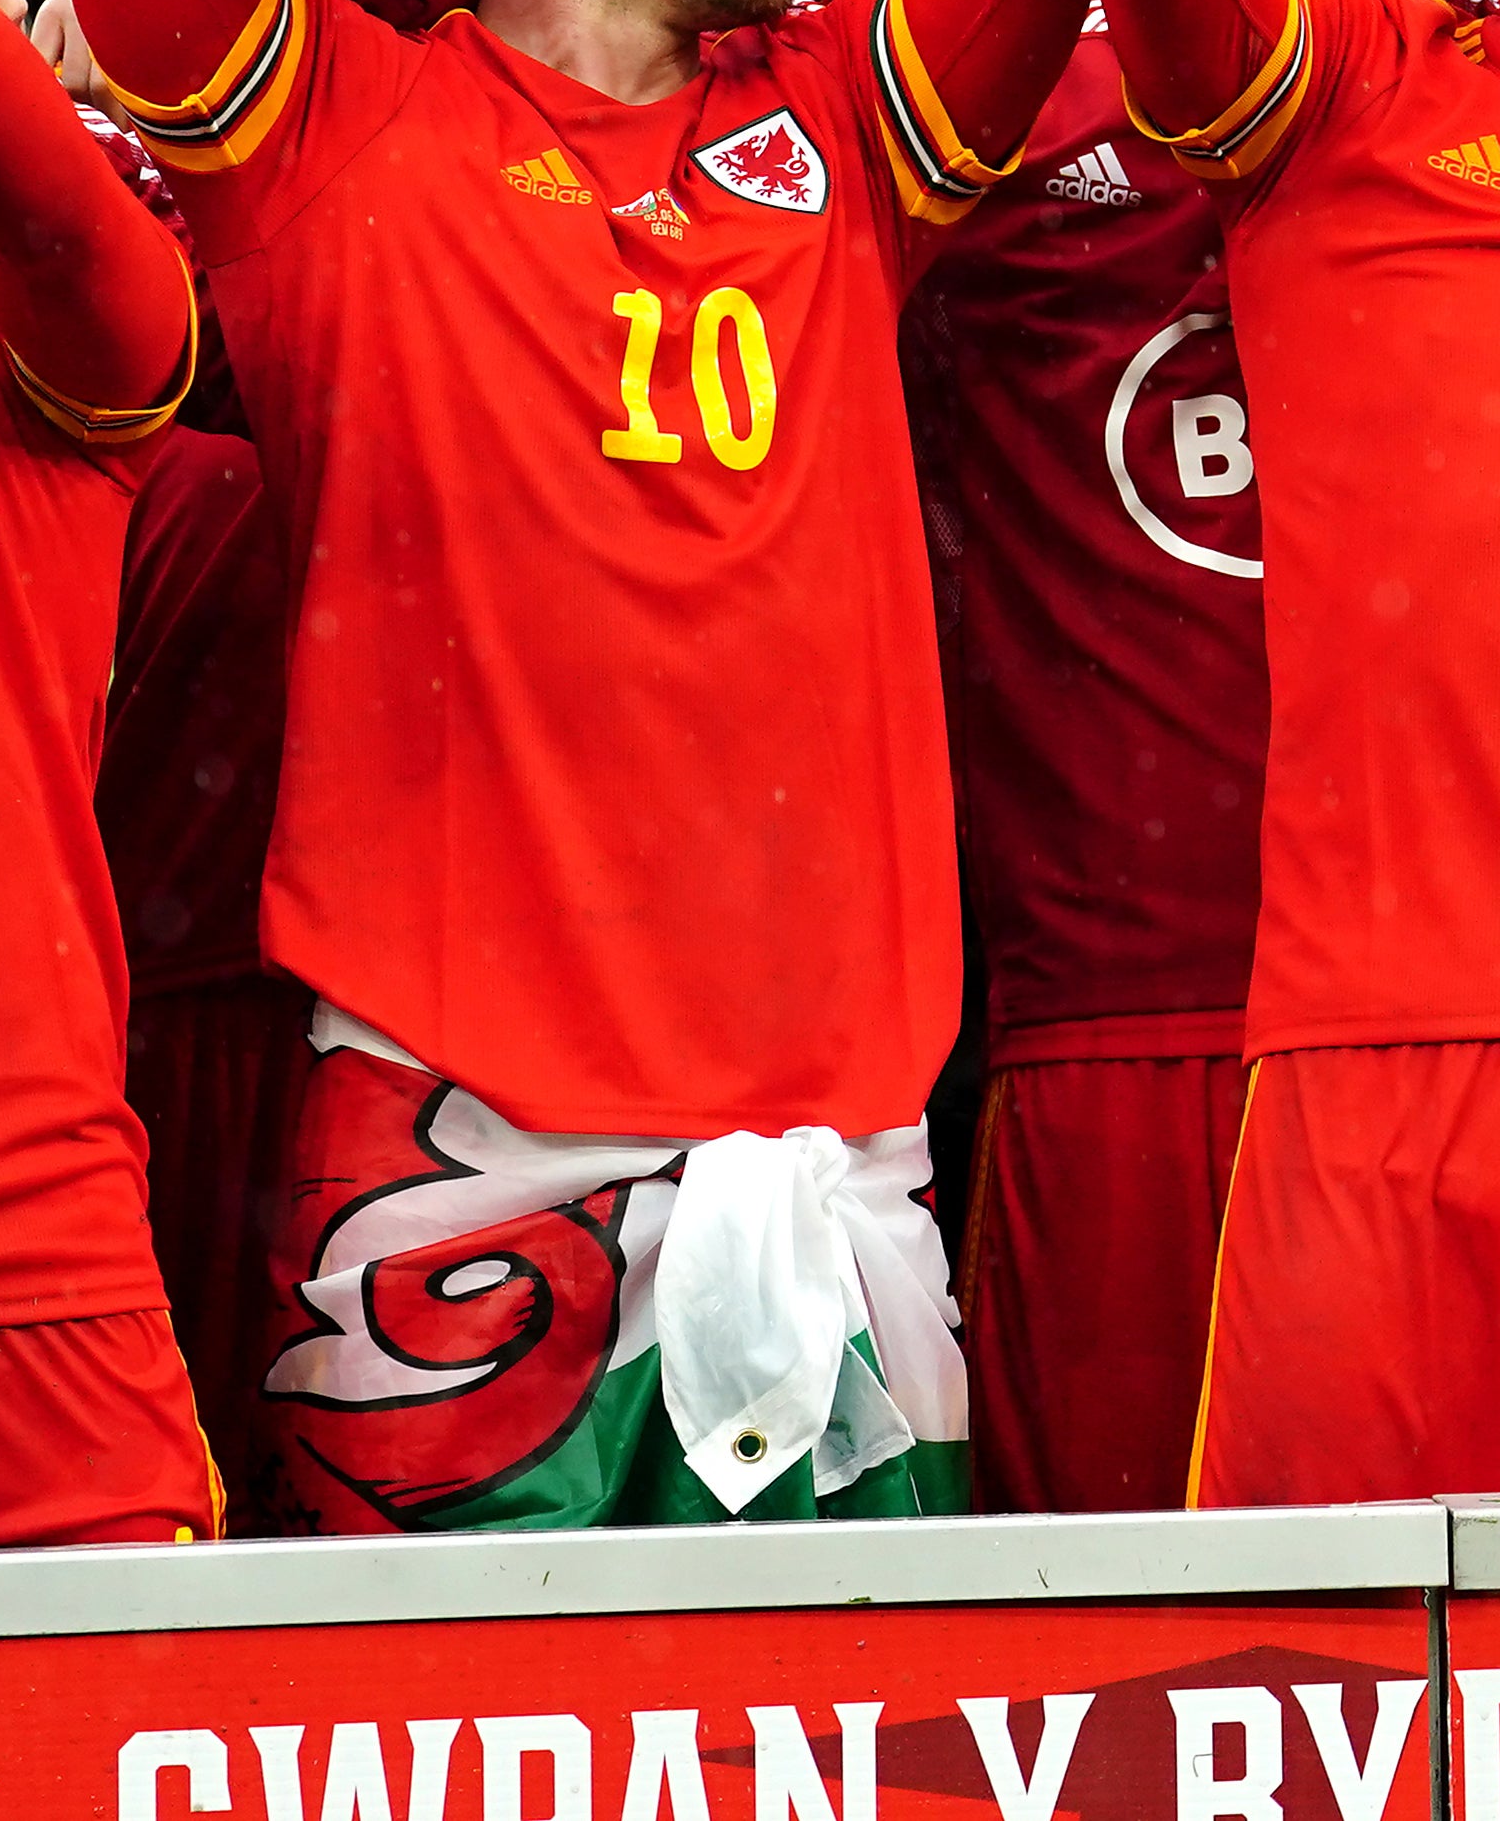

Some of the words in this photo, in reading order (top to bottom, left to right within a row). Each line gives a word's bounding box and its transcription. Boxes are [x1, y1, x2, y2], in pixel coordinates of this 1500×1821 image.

[1045, 177, 1143, 208] adidas
[601, 286, 778, 472] 10
[1172, 394, 1255, 498] B
[955, 1692, 1098, 1821] Y
